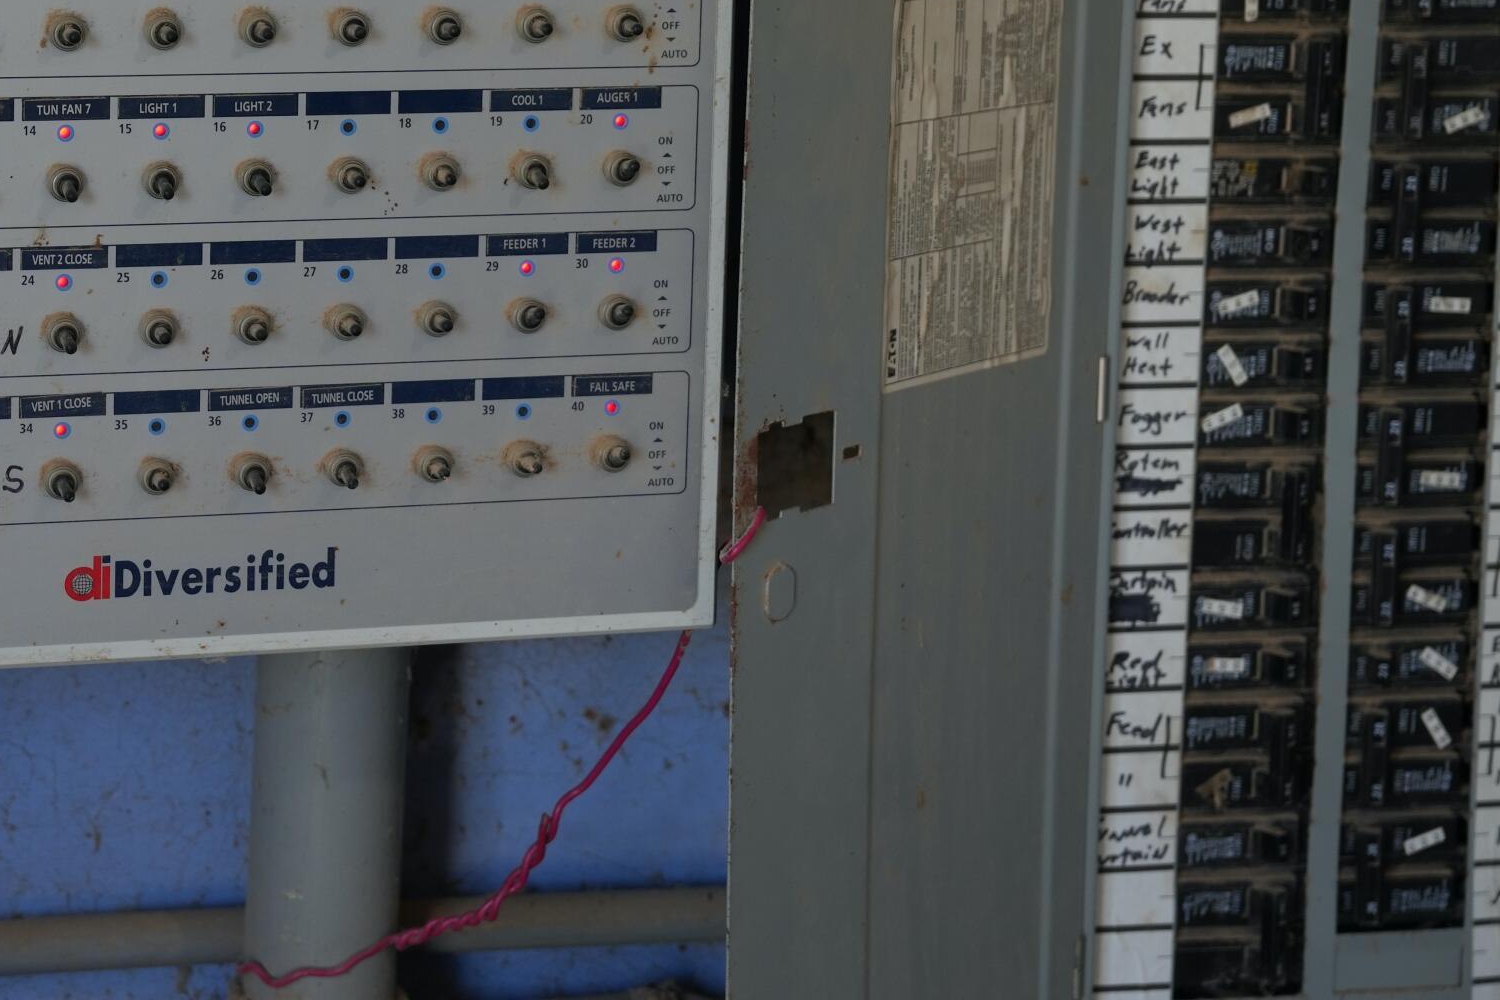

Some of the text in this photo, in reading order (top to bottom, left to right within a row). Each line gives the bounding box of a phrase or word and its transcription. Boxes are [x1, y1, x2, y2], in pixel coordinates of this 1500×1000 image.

[511, 94, 544, 107] COOL 1
[597, 91, 638, 104] AUGER 1
[36, 103, 92, 116] TUN FAN 7
[139, 102, 177, 115] LIGHT 1
[234, 101, 273, 113] LIGHT 2
[503, 237, 546, 250] FEEDER 1
[592, 236, 636, 249] FEEDER 2
[32, 253, 92, 266] VENT 2 CLOSE
[1, 326, 24, 356] N
[589, 379, 636, 393] FAIL SAFE
[220, 391, 280, 406] TUNNEL OPEN
[311, 389, 374, 404] TUNNEL CLOSE
[31, 397, 92, 412] VENT 1 CLOSE
[2, 464, 25, 494] S
[114, 546, 339, 598] Diversified
